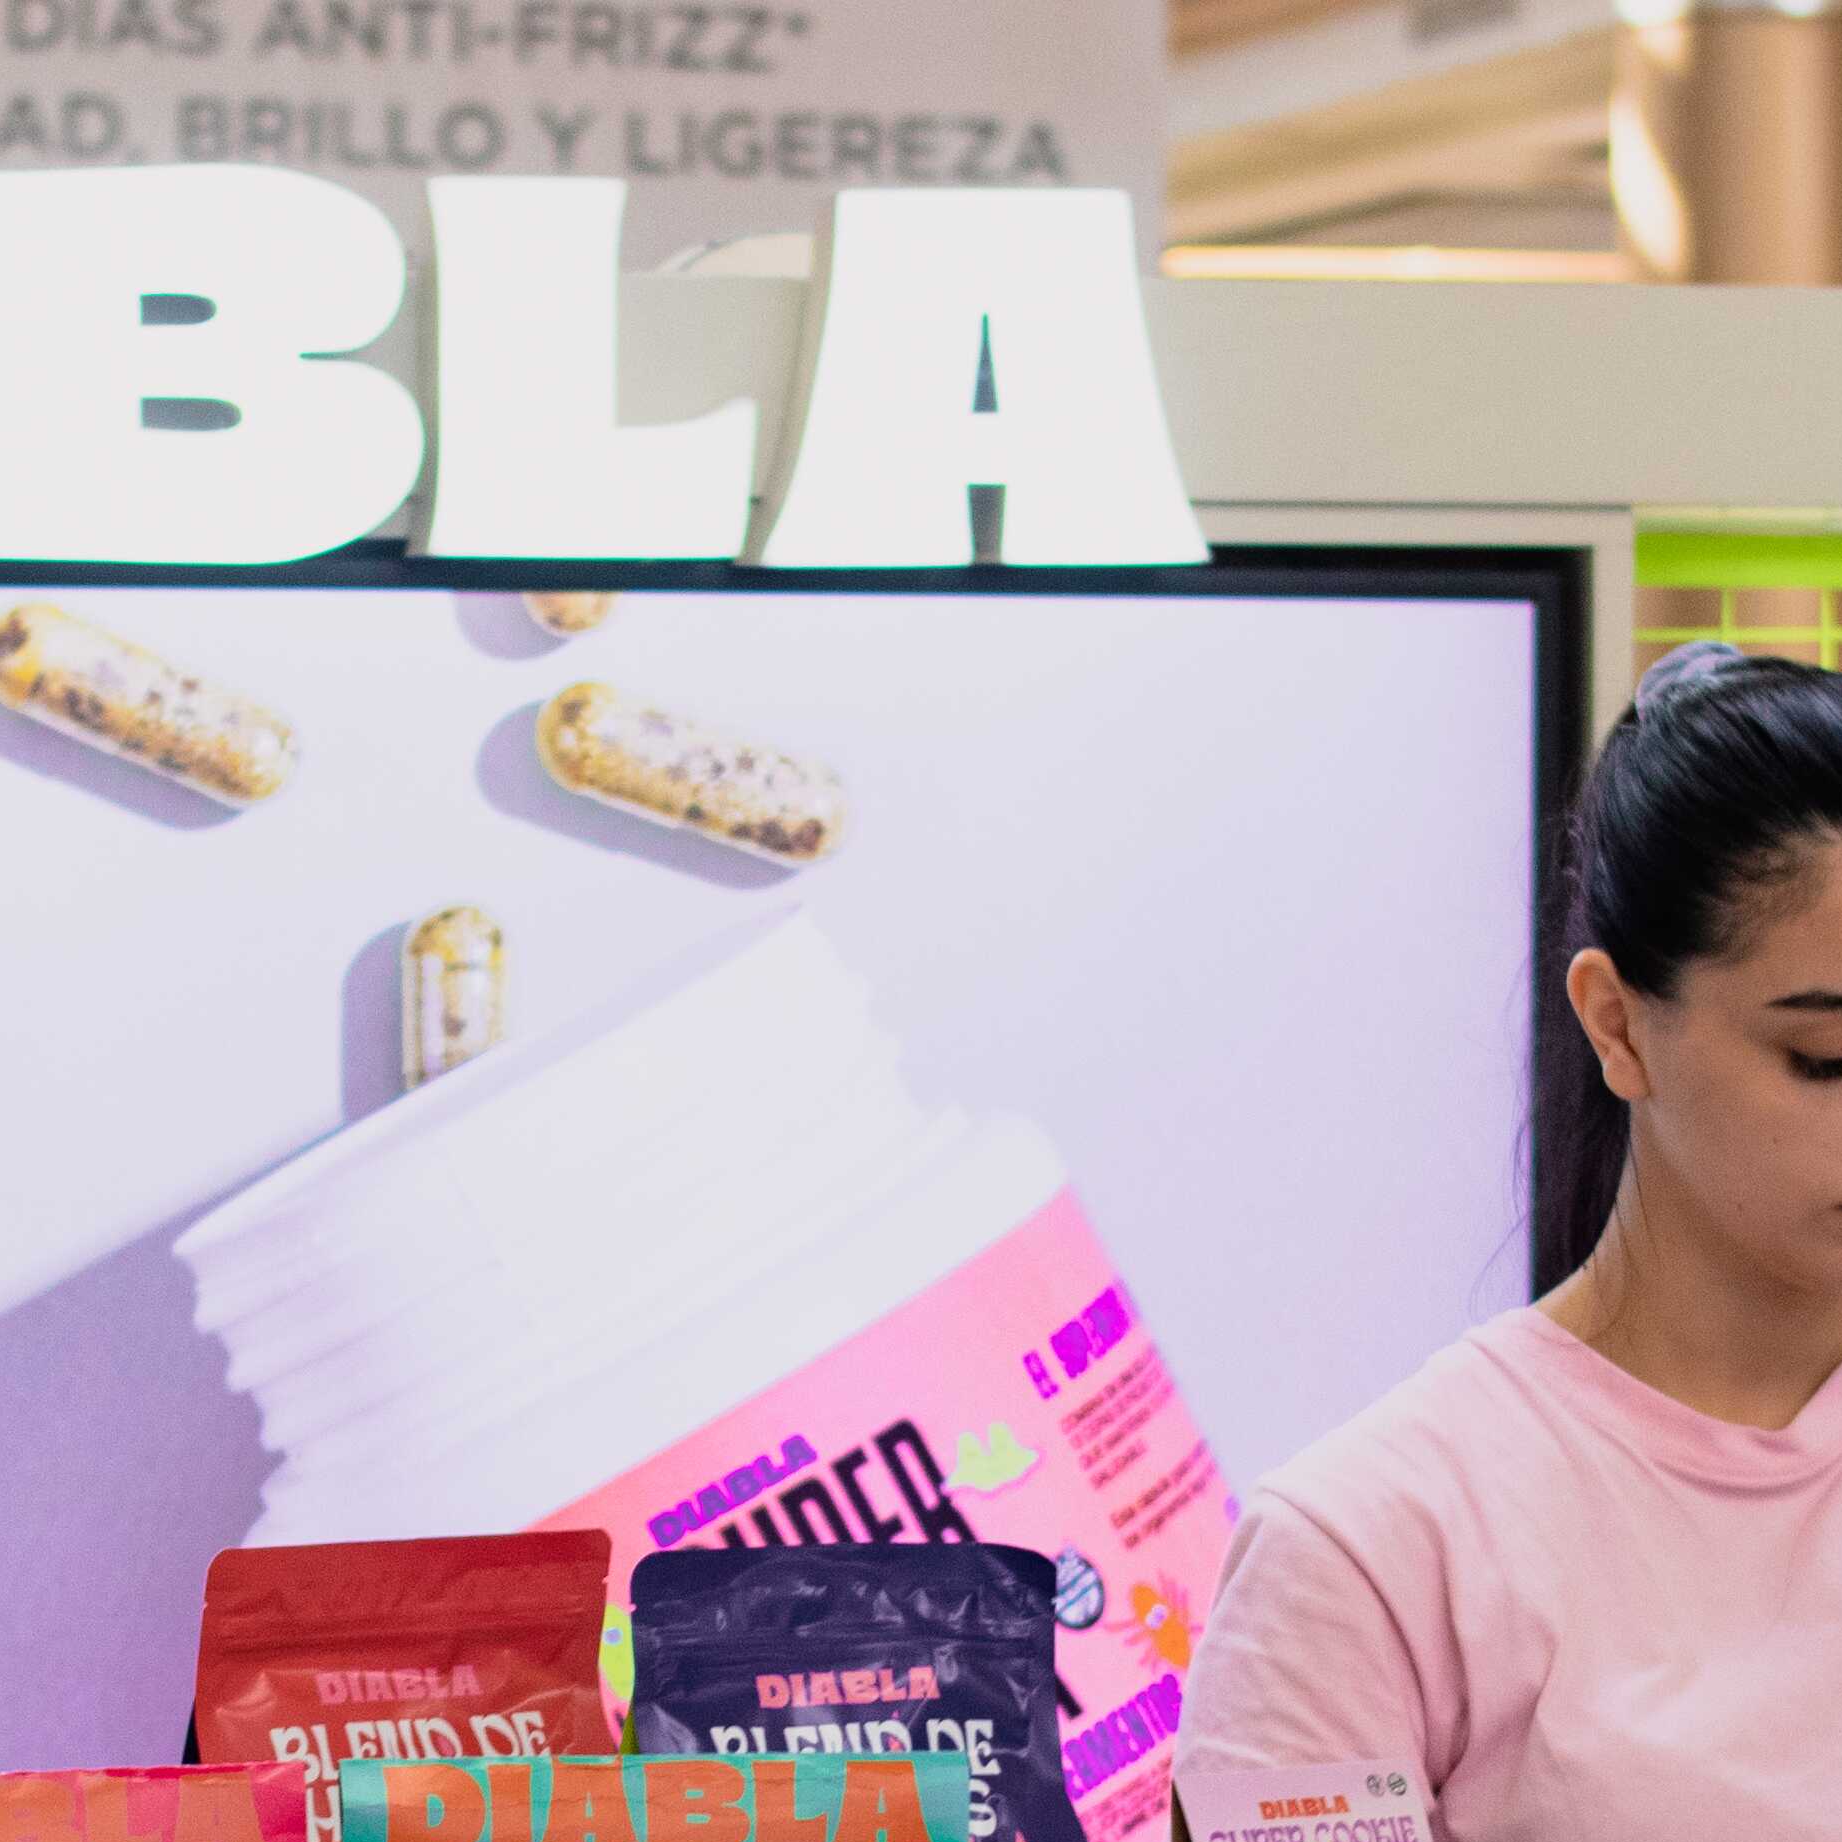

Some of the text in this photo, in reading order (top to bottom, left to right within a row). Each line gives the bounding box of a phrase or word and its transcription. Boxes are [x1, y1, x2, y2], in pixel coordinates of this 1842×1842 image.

[175, 92, 506, 170] BRILLO
[536, 105, 596, 171] Y
[625, 108, 1068, 182] LIGEREZA
[646, 1434, 818, 1549] DIABLA
[315, 1665, 482, 1705] DIABLA
[755, 1665, 941, 1709] DIABLA
[1259, 1795, 1350, 1820] DIABLA
